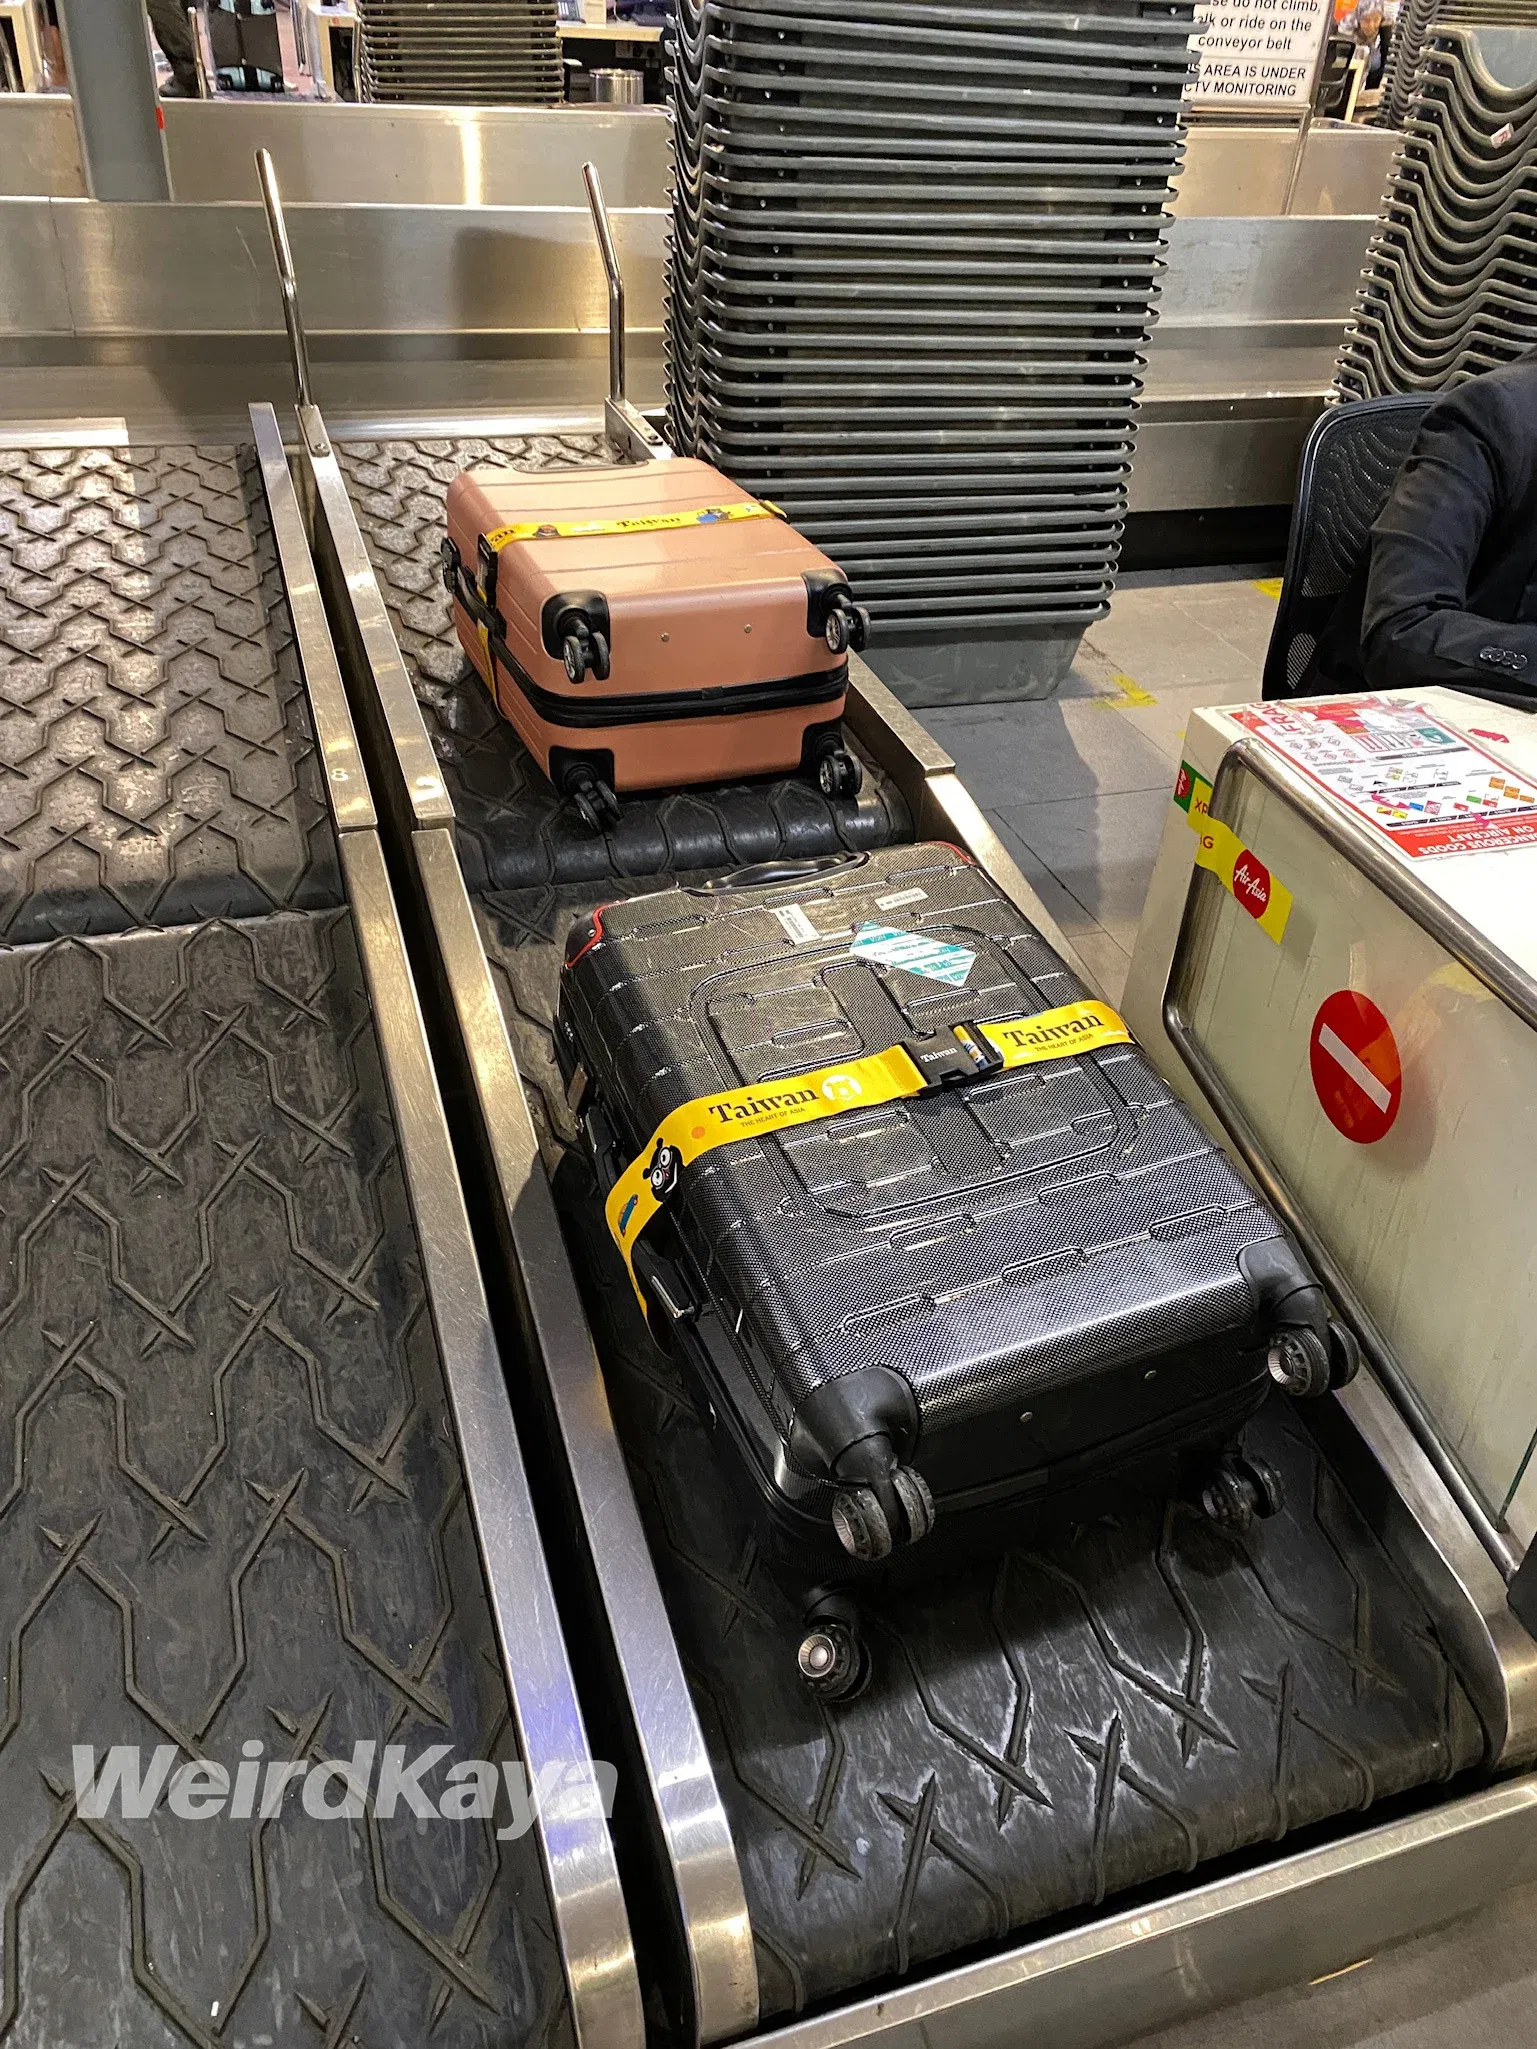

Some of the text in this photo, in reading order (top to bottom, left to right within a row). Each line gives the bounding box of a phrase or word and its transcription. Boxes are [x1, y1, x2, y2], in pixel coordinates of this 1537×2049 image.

[1221, 17, 1234, 27] or
[1239, 15, 1265, 30] ride
[1269, 19, 1287, 30] on
[1291, 17, 1312, 32] the
[1198, 35, 1292, 51] conveyor belt
[1204, 64, 1241, 77] AREA
[1245, 66, 1257, 77] IS
[1261, 67, 1307, 79] UNDER
[1213, 82, 1297, 97] MONITORING
[1003, 1013, 1105, 1047] Taiwan
[1035, 1043, 1049, 1052] THE
[1050, 1040, 1068, 1051] HEART
[1078, 1033, 1094, 1044] ASIA
[920, 1046, 958, 1063] Taiwan
[708, 1089, 820, 1123] Taiwan
[741, 1119, 755, 1128] THE
[756, 1114, 779, 1125] HEART
[790, 1106, 806, 1116] ASIA
